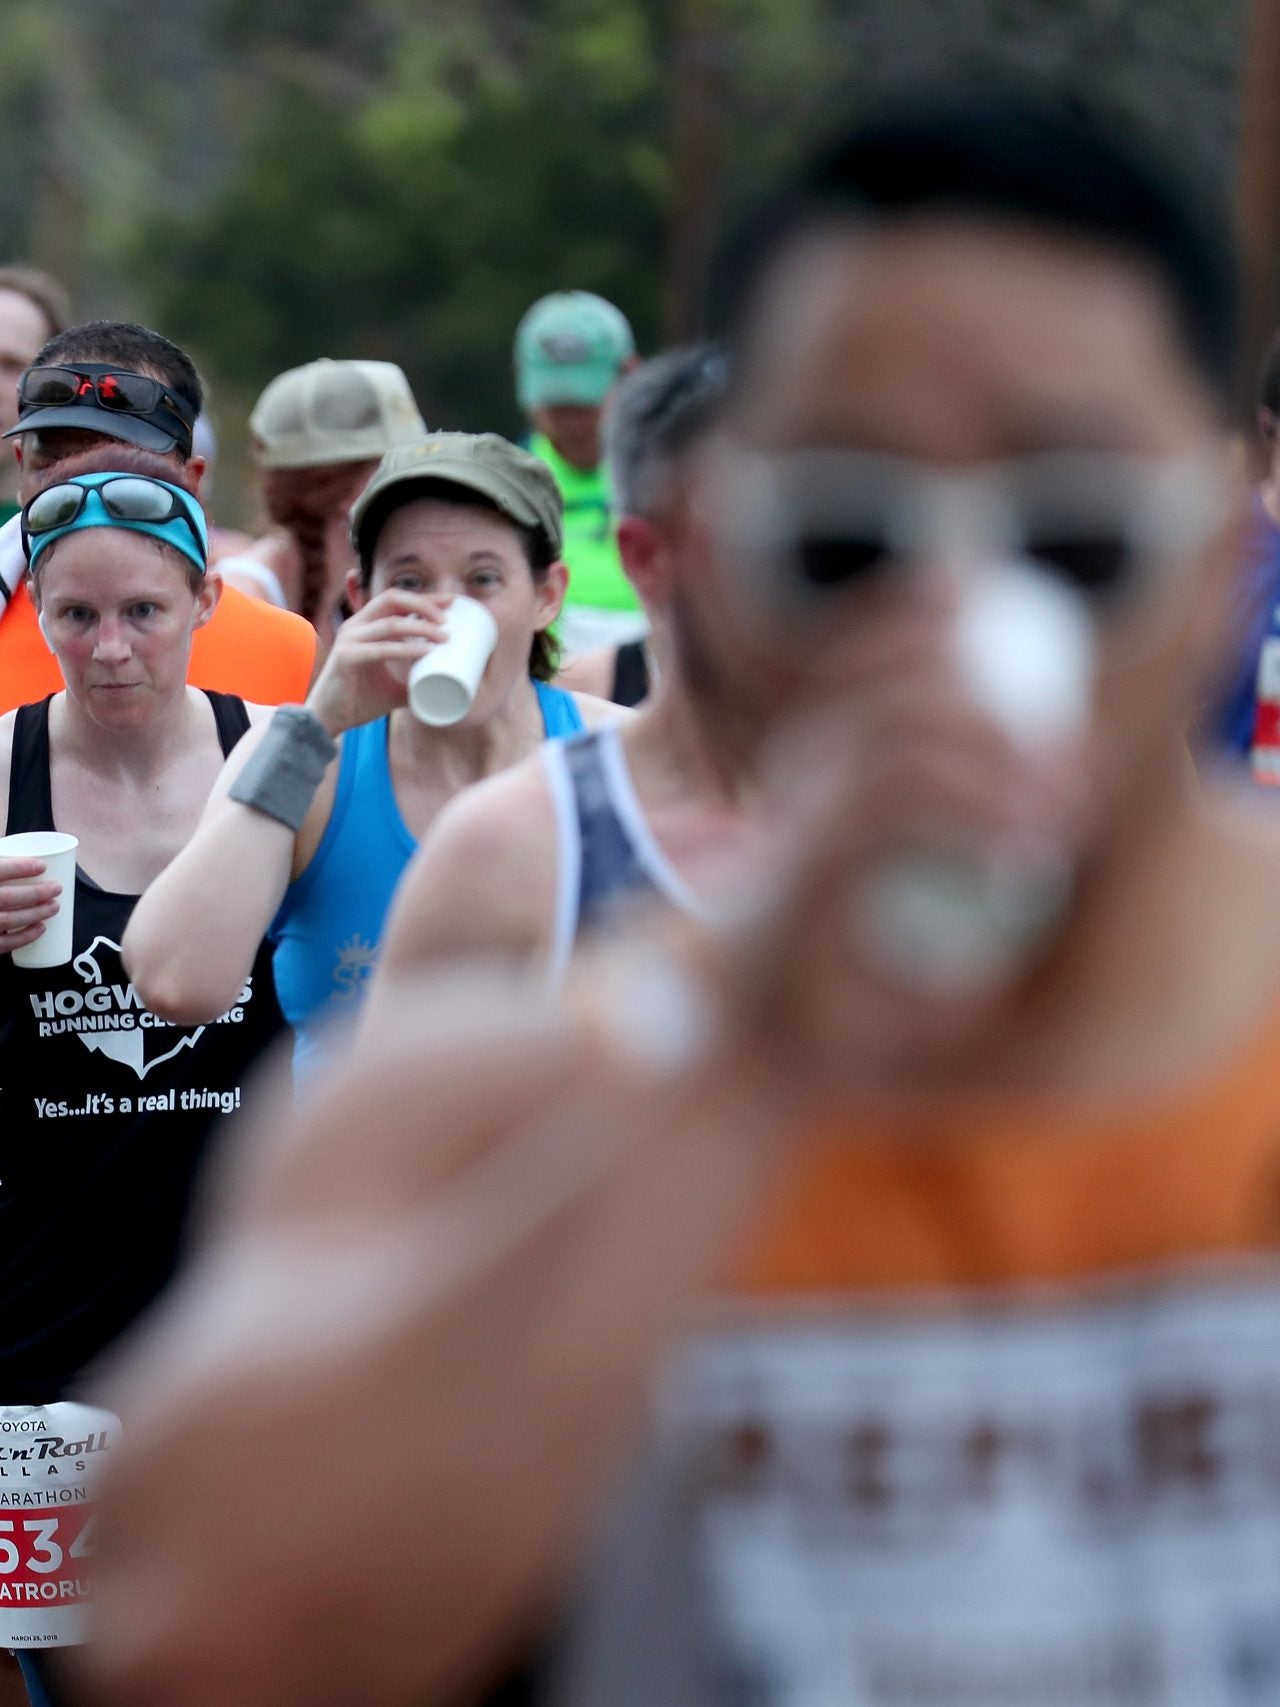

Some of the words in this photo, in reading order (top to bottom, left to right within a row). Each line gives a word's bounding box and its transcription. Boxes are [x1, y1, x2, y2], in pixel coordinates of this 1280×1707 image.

[29, 976, 253, 1018] HOGWS
[39, 1013, 135, 1037] RUNNING
[120, 1098, 132, 1112] a
[137, 1089, 175, 1112] real
[180, 1087, 241, 1113] thing!
